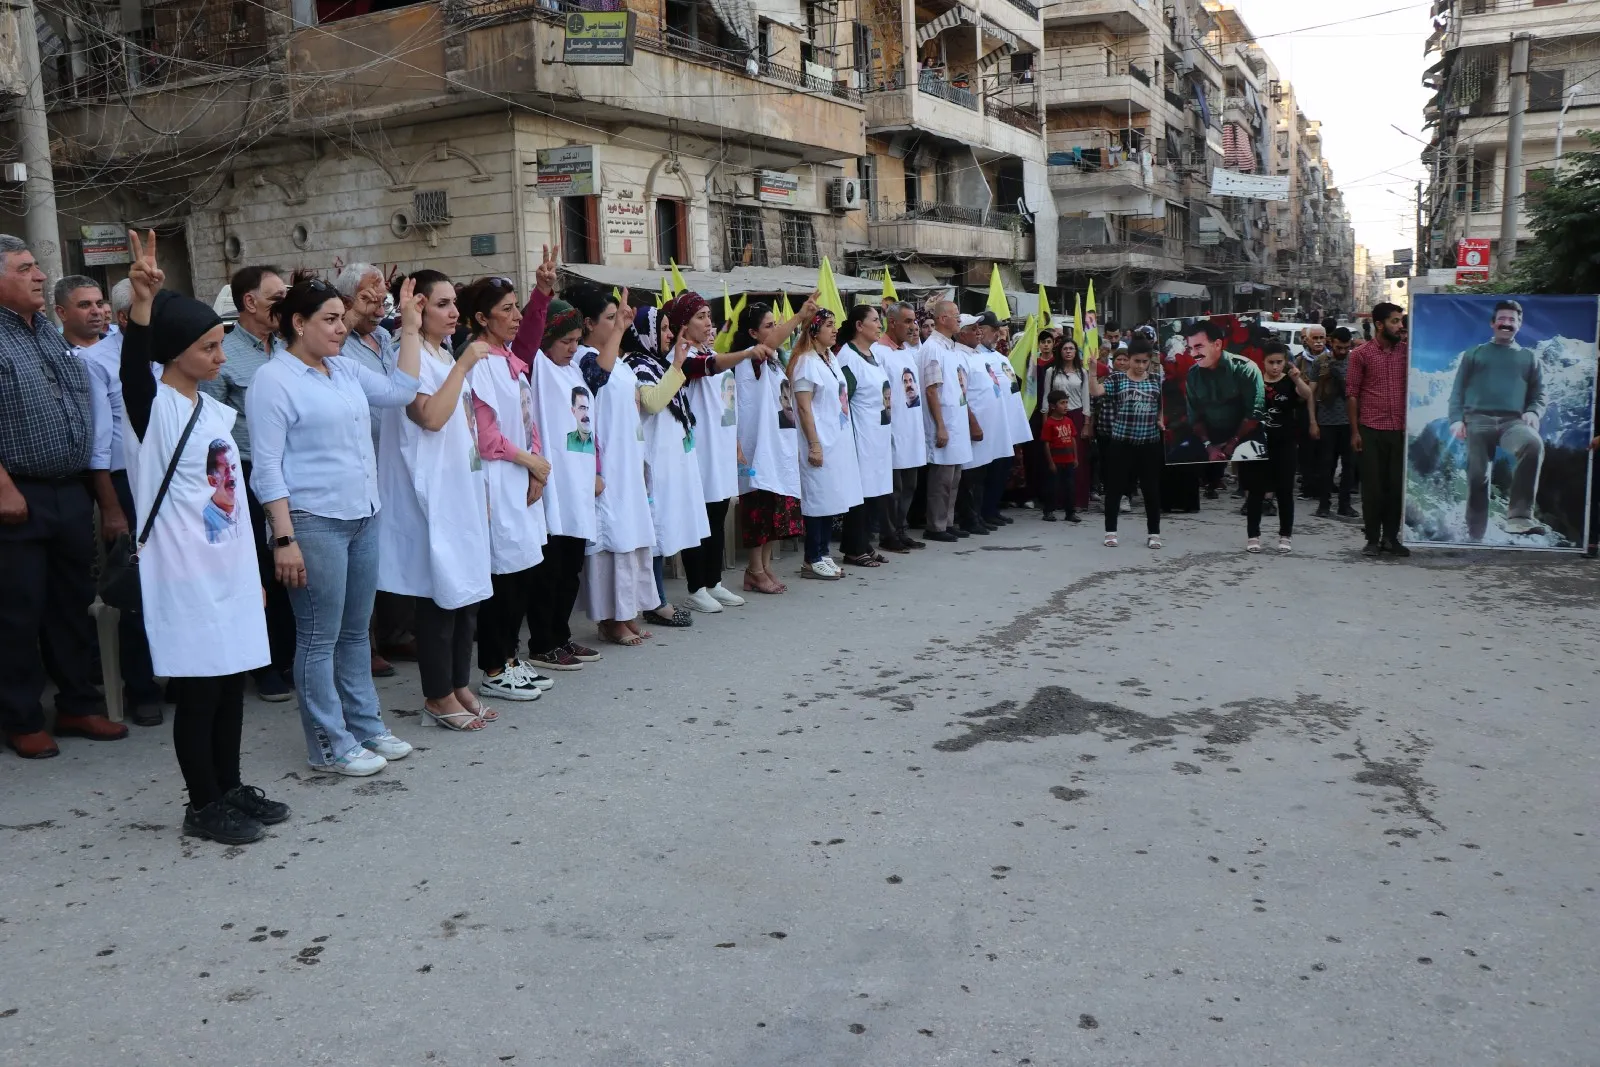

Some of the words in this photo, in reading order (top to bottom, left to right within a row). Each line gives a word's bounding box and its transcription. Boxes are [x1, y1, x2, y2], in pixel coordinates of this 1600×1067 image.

[585, 20, 624, 34] المحامي
[566, 39, 593, 52] جميل
[596, 40, 624, 49] محمد
[559, 151, 580, 162] الدكتور
[97, 229, 116, 238] الدكتور
